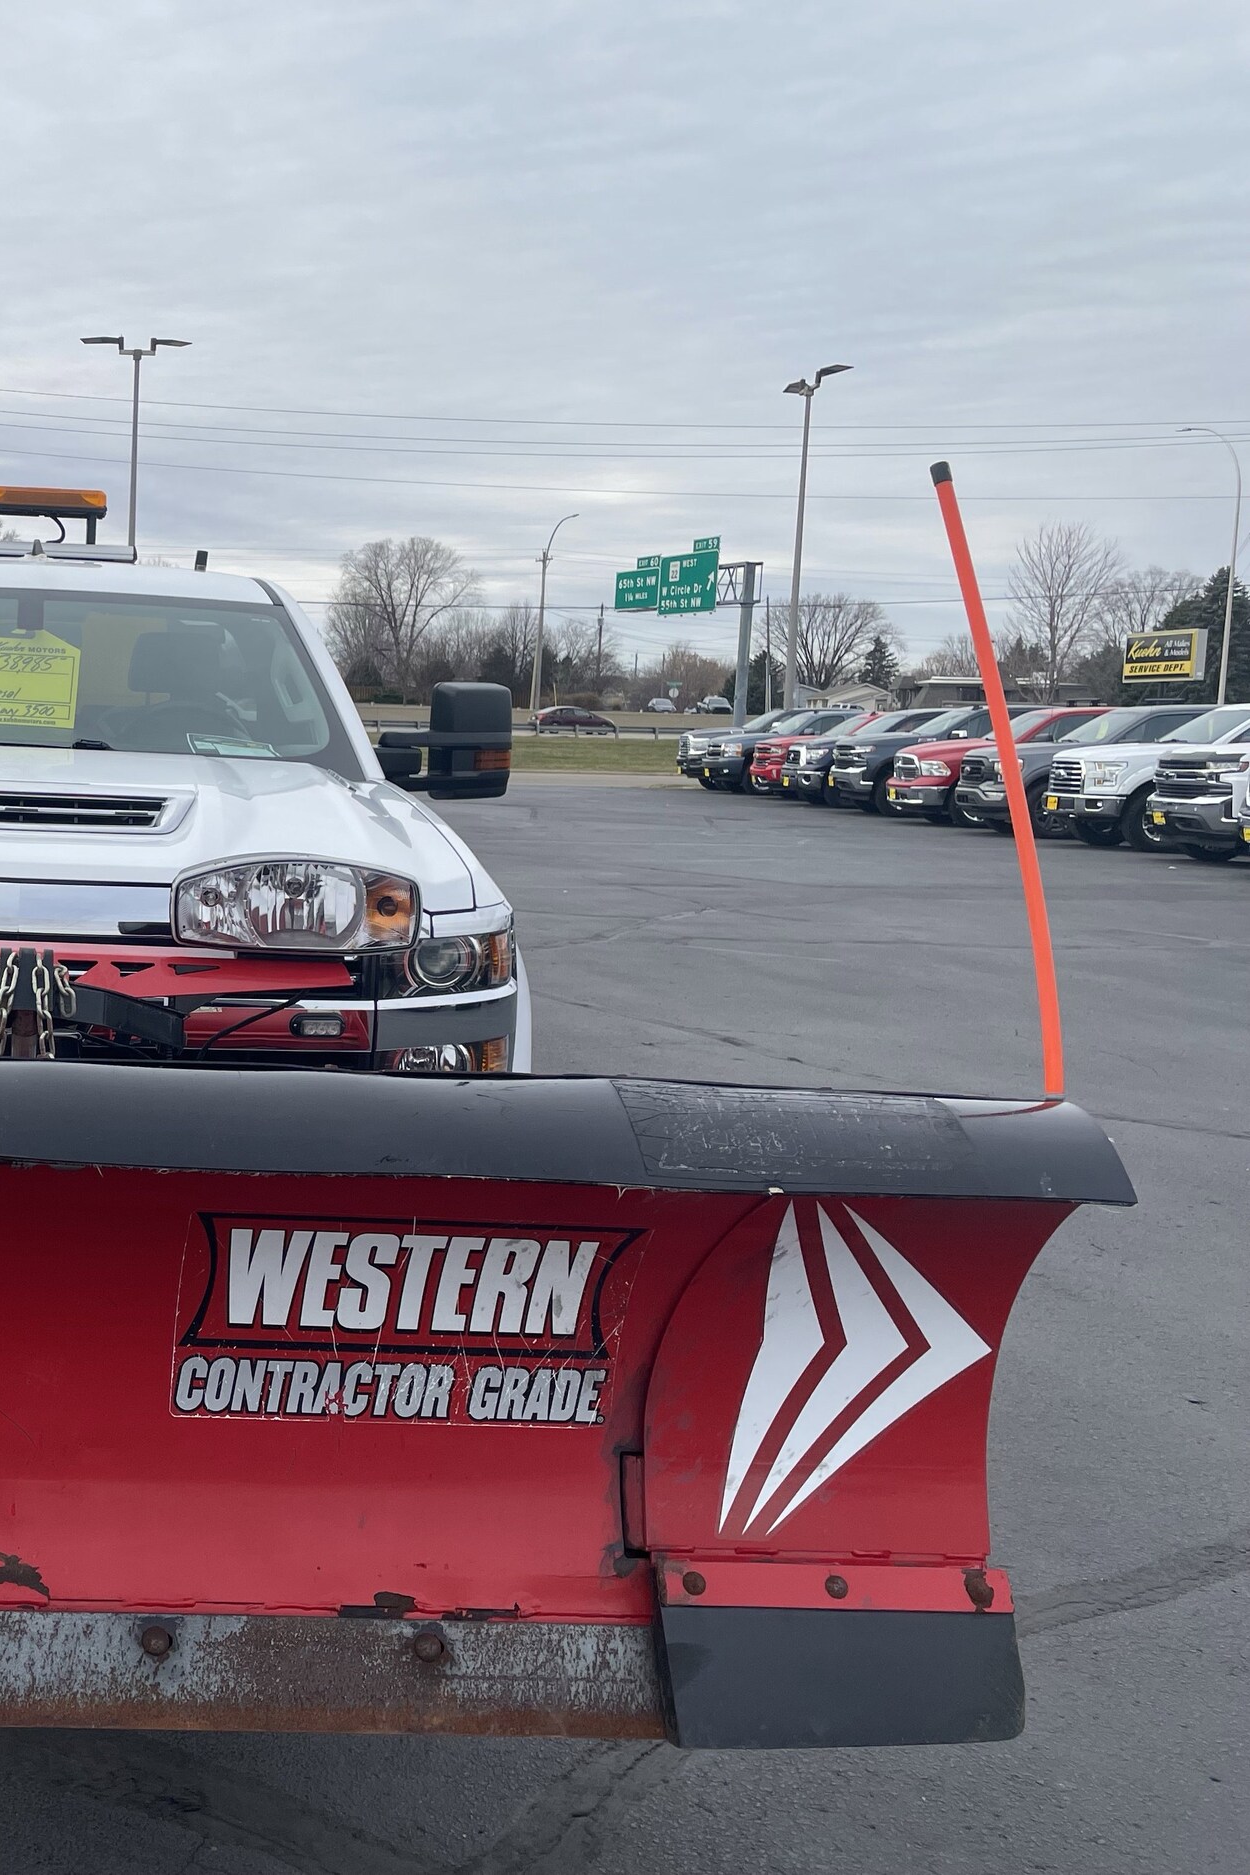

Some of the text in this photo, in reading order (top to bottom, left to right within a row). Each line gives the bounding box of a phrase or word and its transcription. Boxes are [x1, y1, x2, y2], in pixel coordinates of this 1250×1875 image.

[708, 539, 718, 548] 59
[650, 558, 658, 566] 60
[683, 559, 697, 567] WEST
[671, 570, 678, 579] 22
[618, 576, 656, 589] 65th St NW
[662, 583, 702, 596] W Circle Dr
[661, 597, 701, 610] 55th St NW
[1128, 639, 1162, 660] Kuehn
[1129, 663, 1184, 673] SERVICE DEPT.
[24, 704, 55, 717] 3500
[228, 1228, 600, 1336] WESTERN
[176, 1356, 456, 1418] CONTRACTOR
